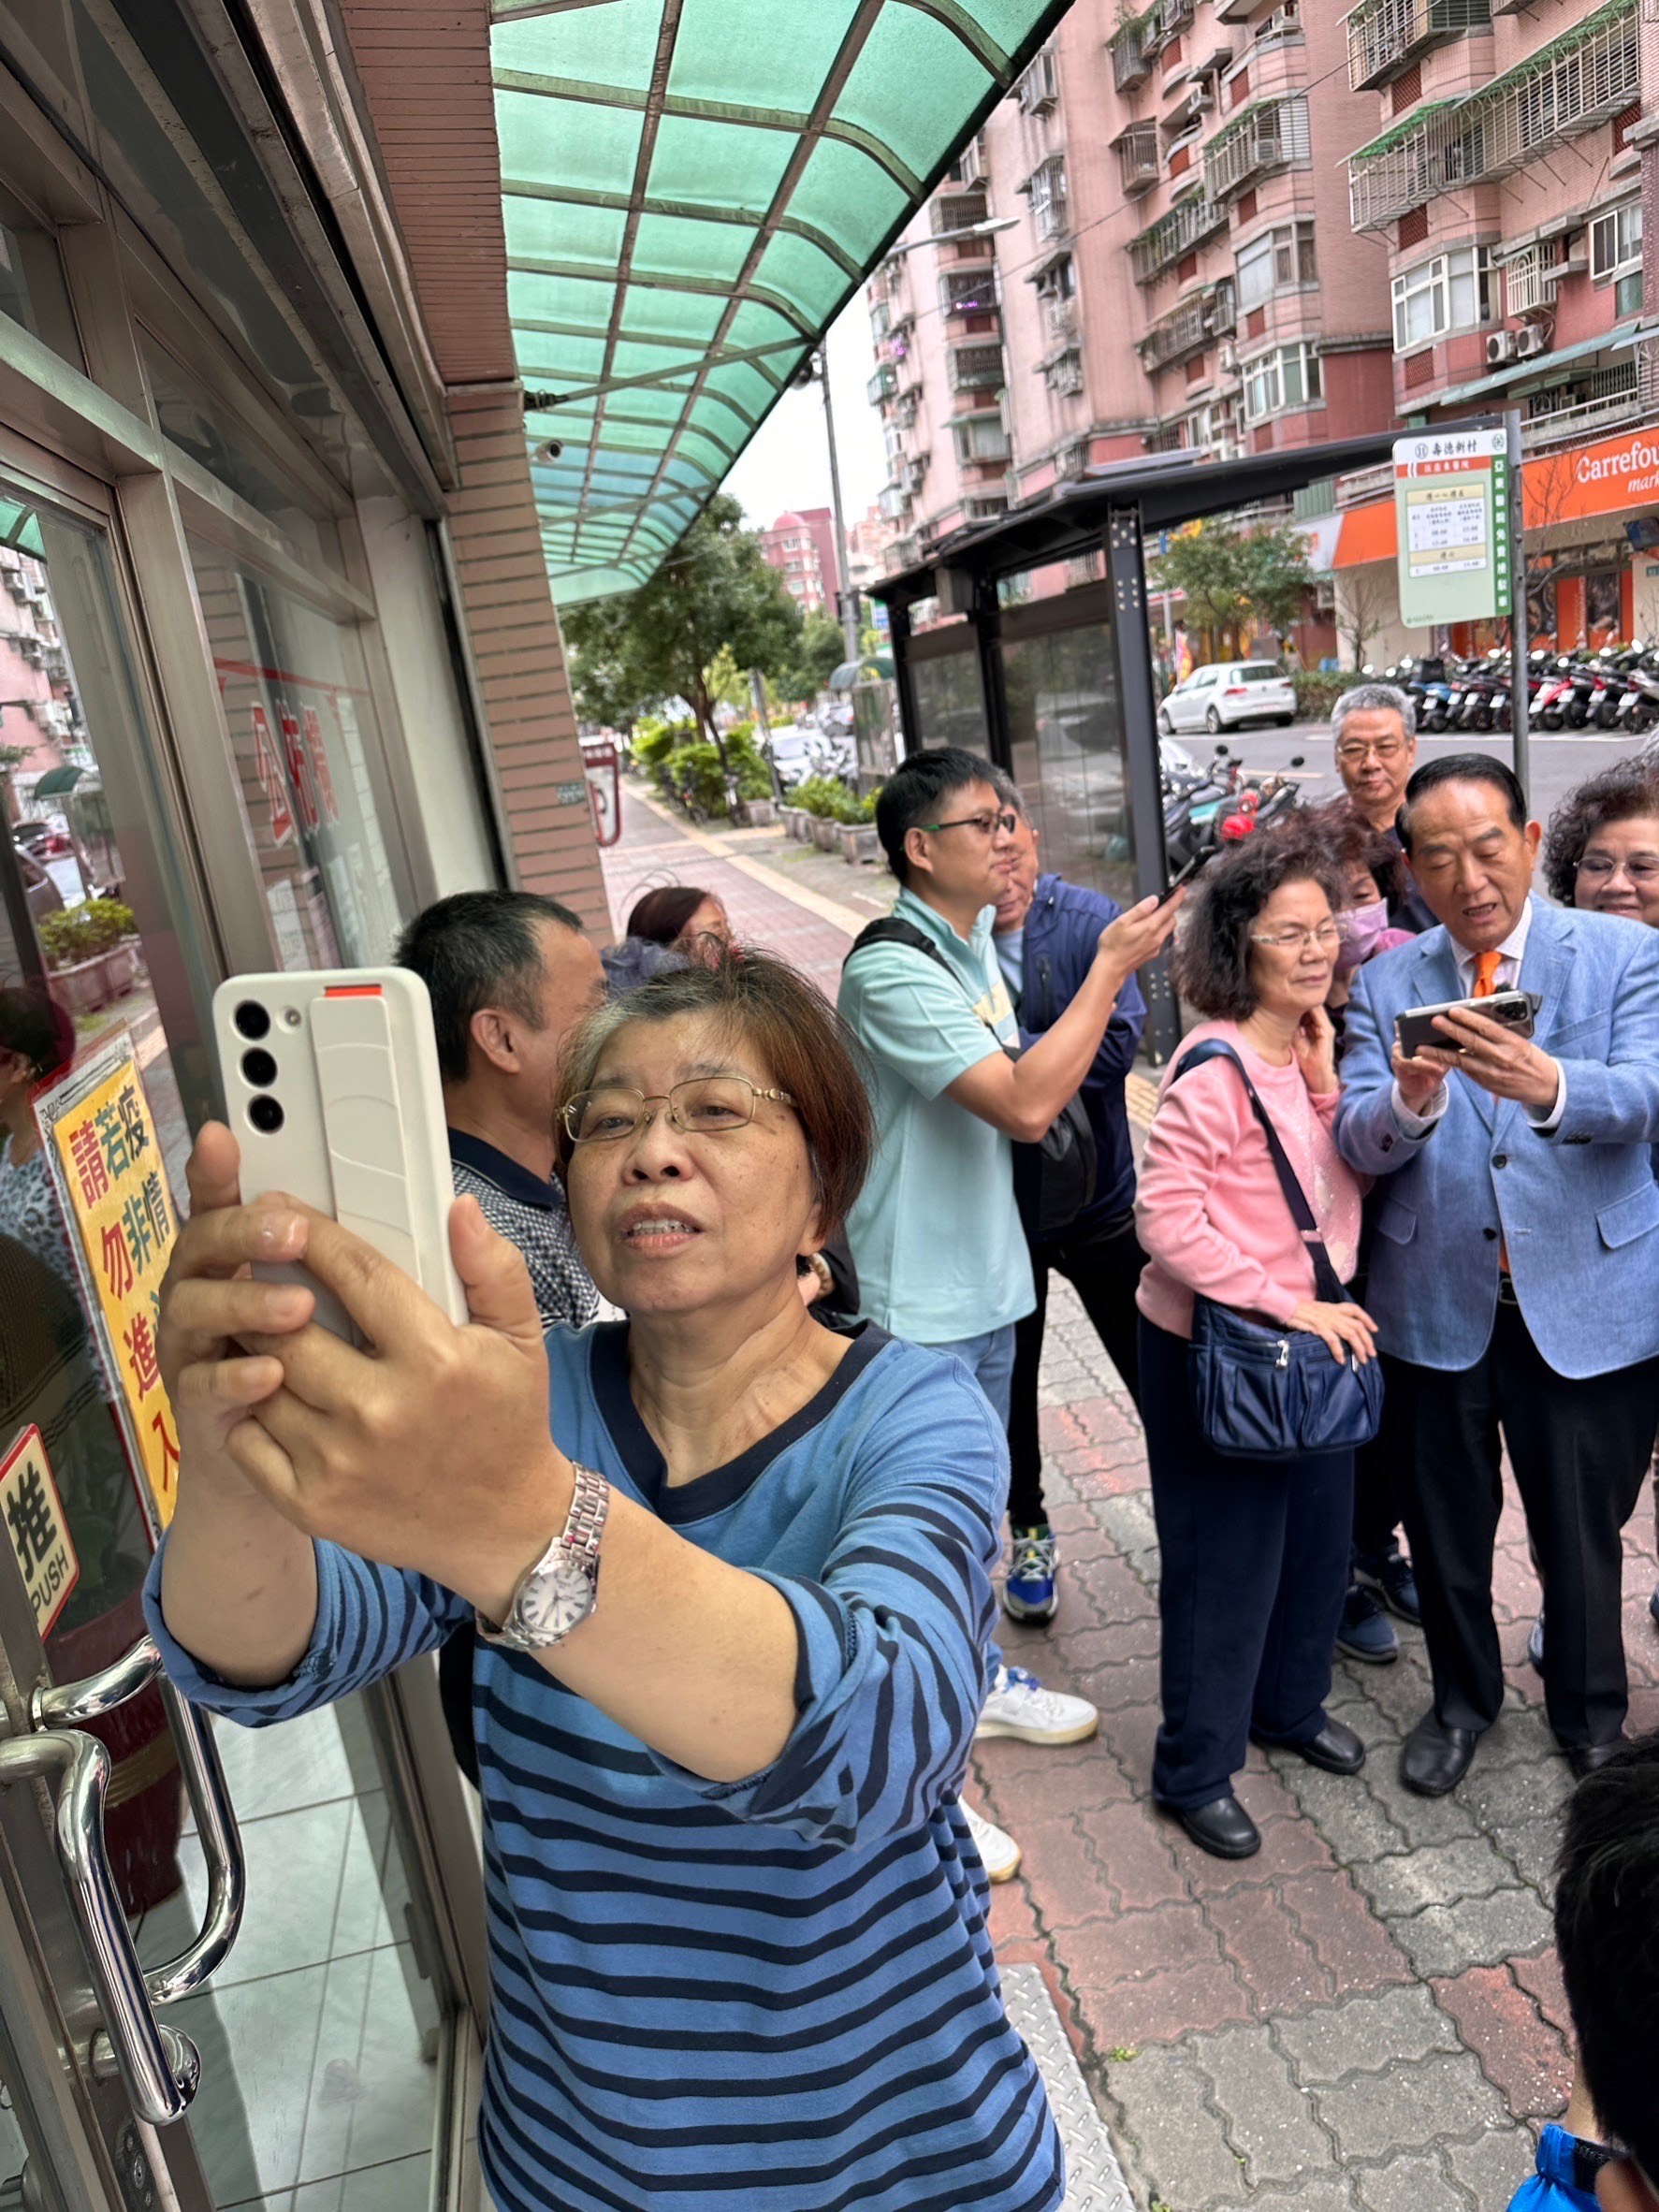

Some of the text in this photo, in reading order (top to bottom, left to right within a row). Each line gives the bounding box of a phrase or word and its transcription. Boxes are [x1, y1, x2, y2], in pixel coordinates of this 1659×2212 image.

[94, 1100, 161, 1334] 若非
[117, 1084, 171, 1249] 疫情
[68, 1119, 181, 1492] 請勿進入
[7, 1461, 57, 1583] 推
[30, 1544, 69, 1625] PUSH
